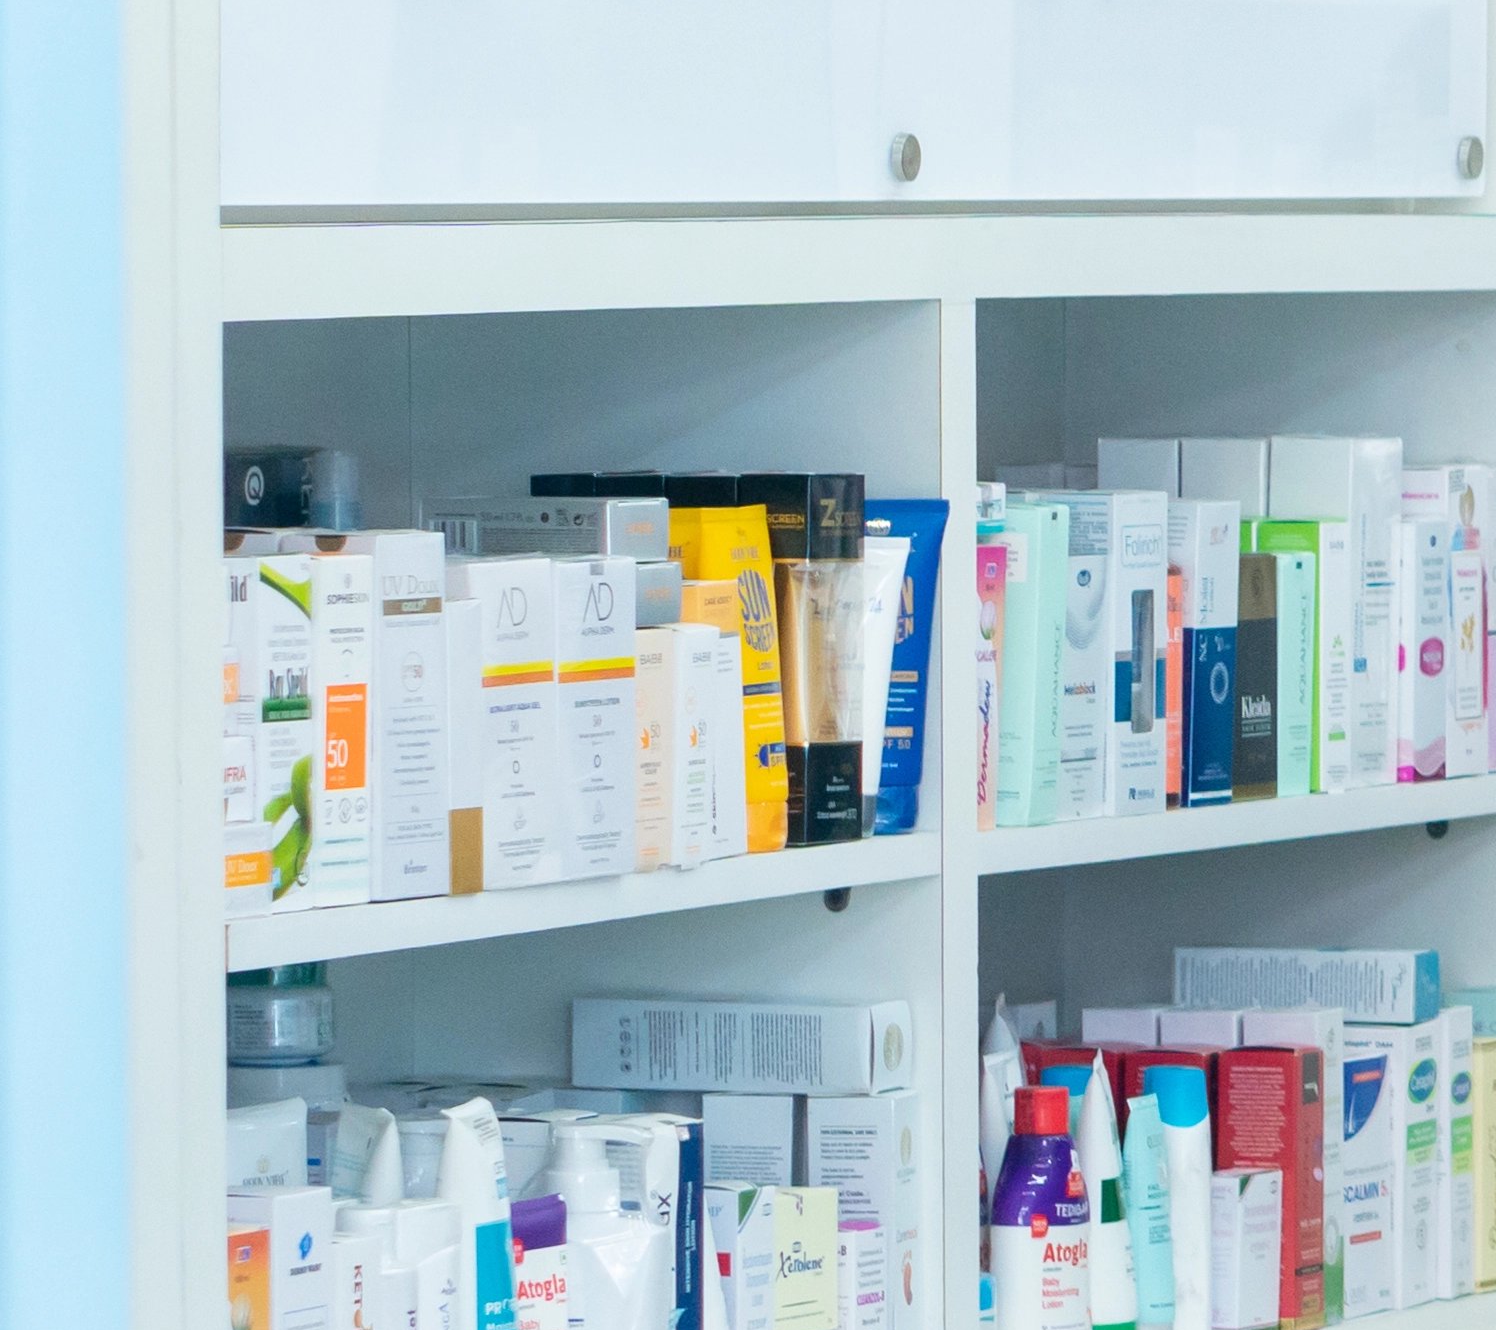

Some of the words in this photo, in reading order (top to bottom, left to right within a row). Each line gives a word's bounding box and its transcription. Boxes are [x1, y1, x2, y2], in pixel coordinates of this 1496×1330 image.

[738, 569, 771, 622] SUN
[1240, 694, 1272, 719] Kleida
[327, 738, 349, 769] 50
[977, 679, 992, 807] Dermadew
[1042, 1238, 1088, 1266] Atogla
[517, 1273, 567, 1302] Atogla
